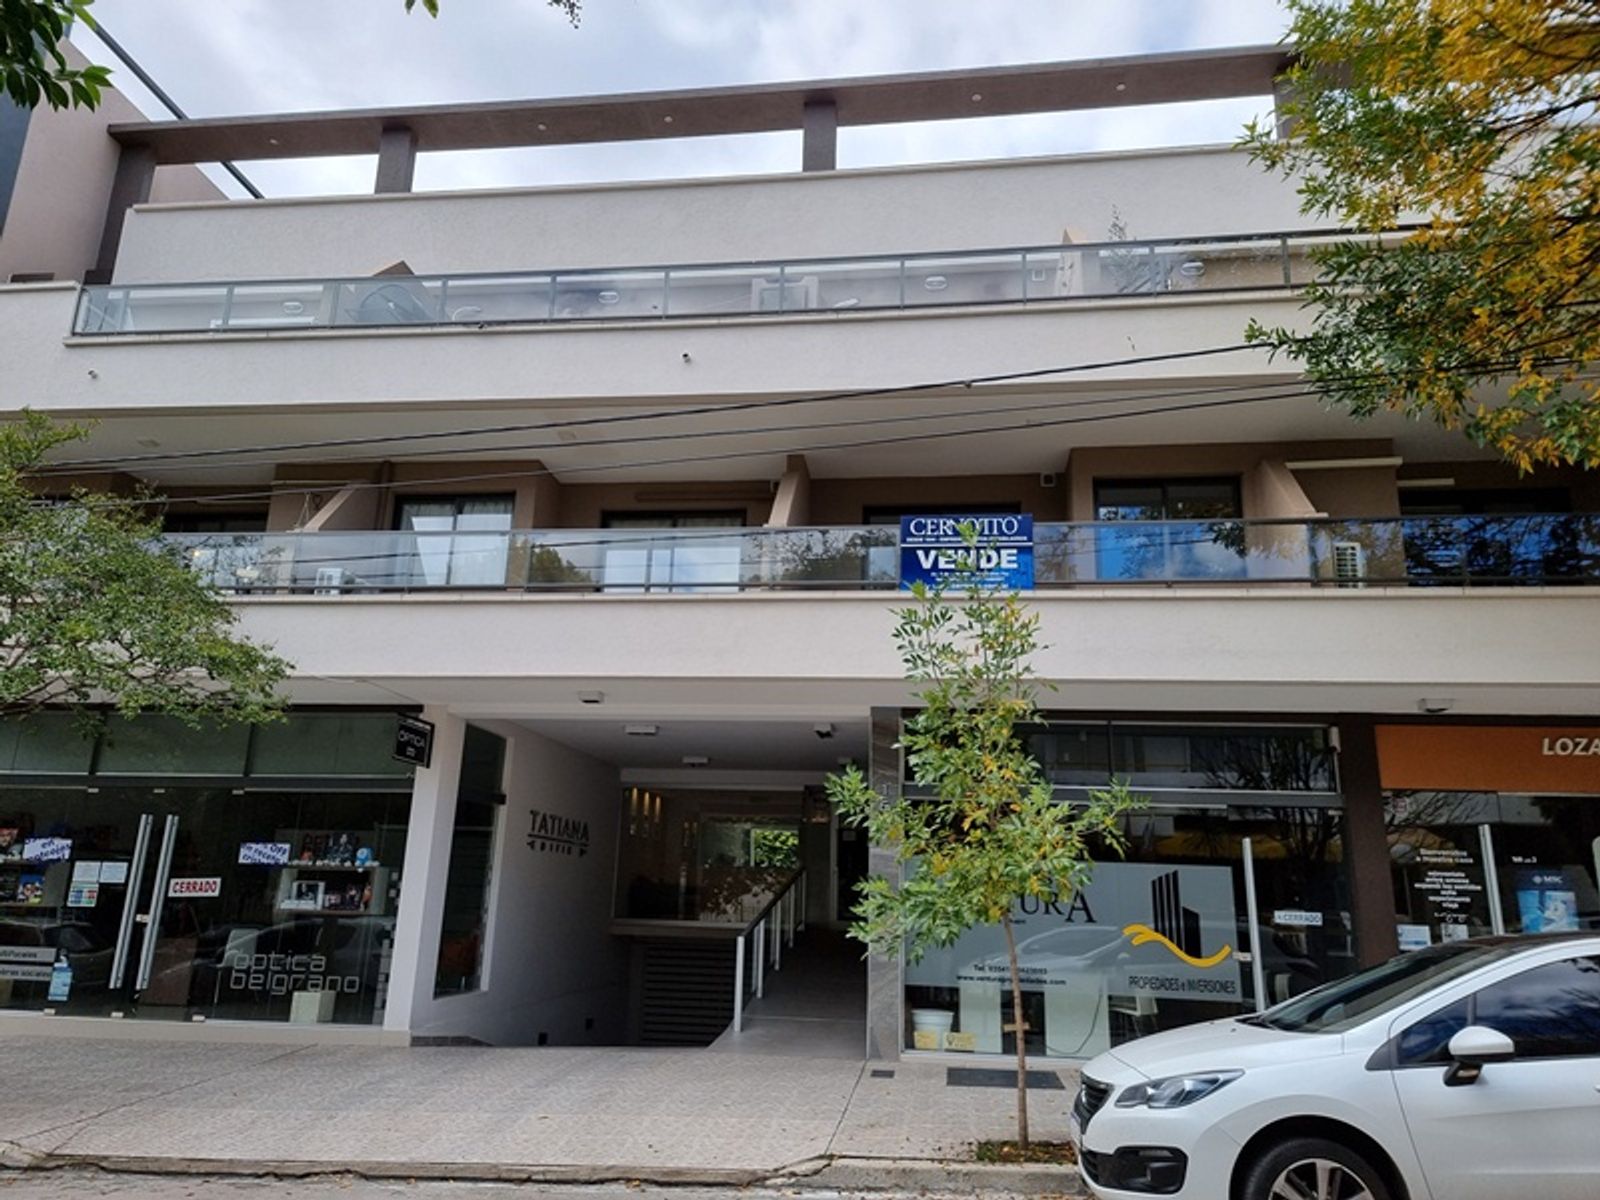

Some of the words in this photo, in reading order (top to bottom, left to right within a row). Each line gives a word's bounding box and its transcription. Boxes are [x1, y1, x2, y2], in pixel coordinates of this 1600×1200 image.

[916, 548, 1018, 570] VENDE
[529, 809, 590, 842] TATIANA
[172, 880, 218, 894] CERRADO
[229, 970, 360, 996] belgrano
[1187, 978, 1237, 994] INVERSIONES
